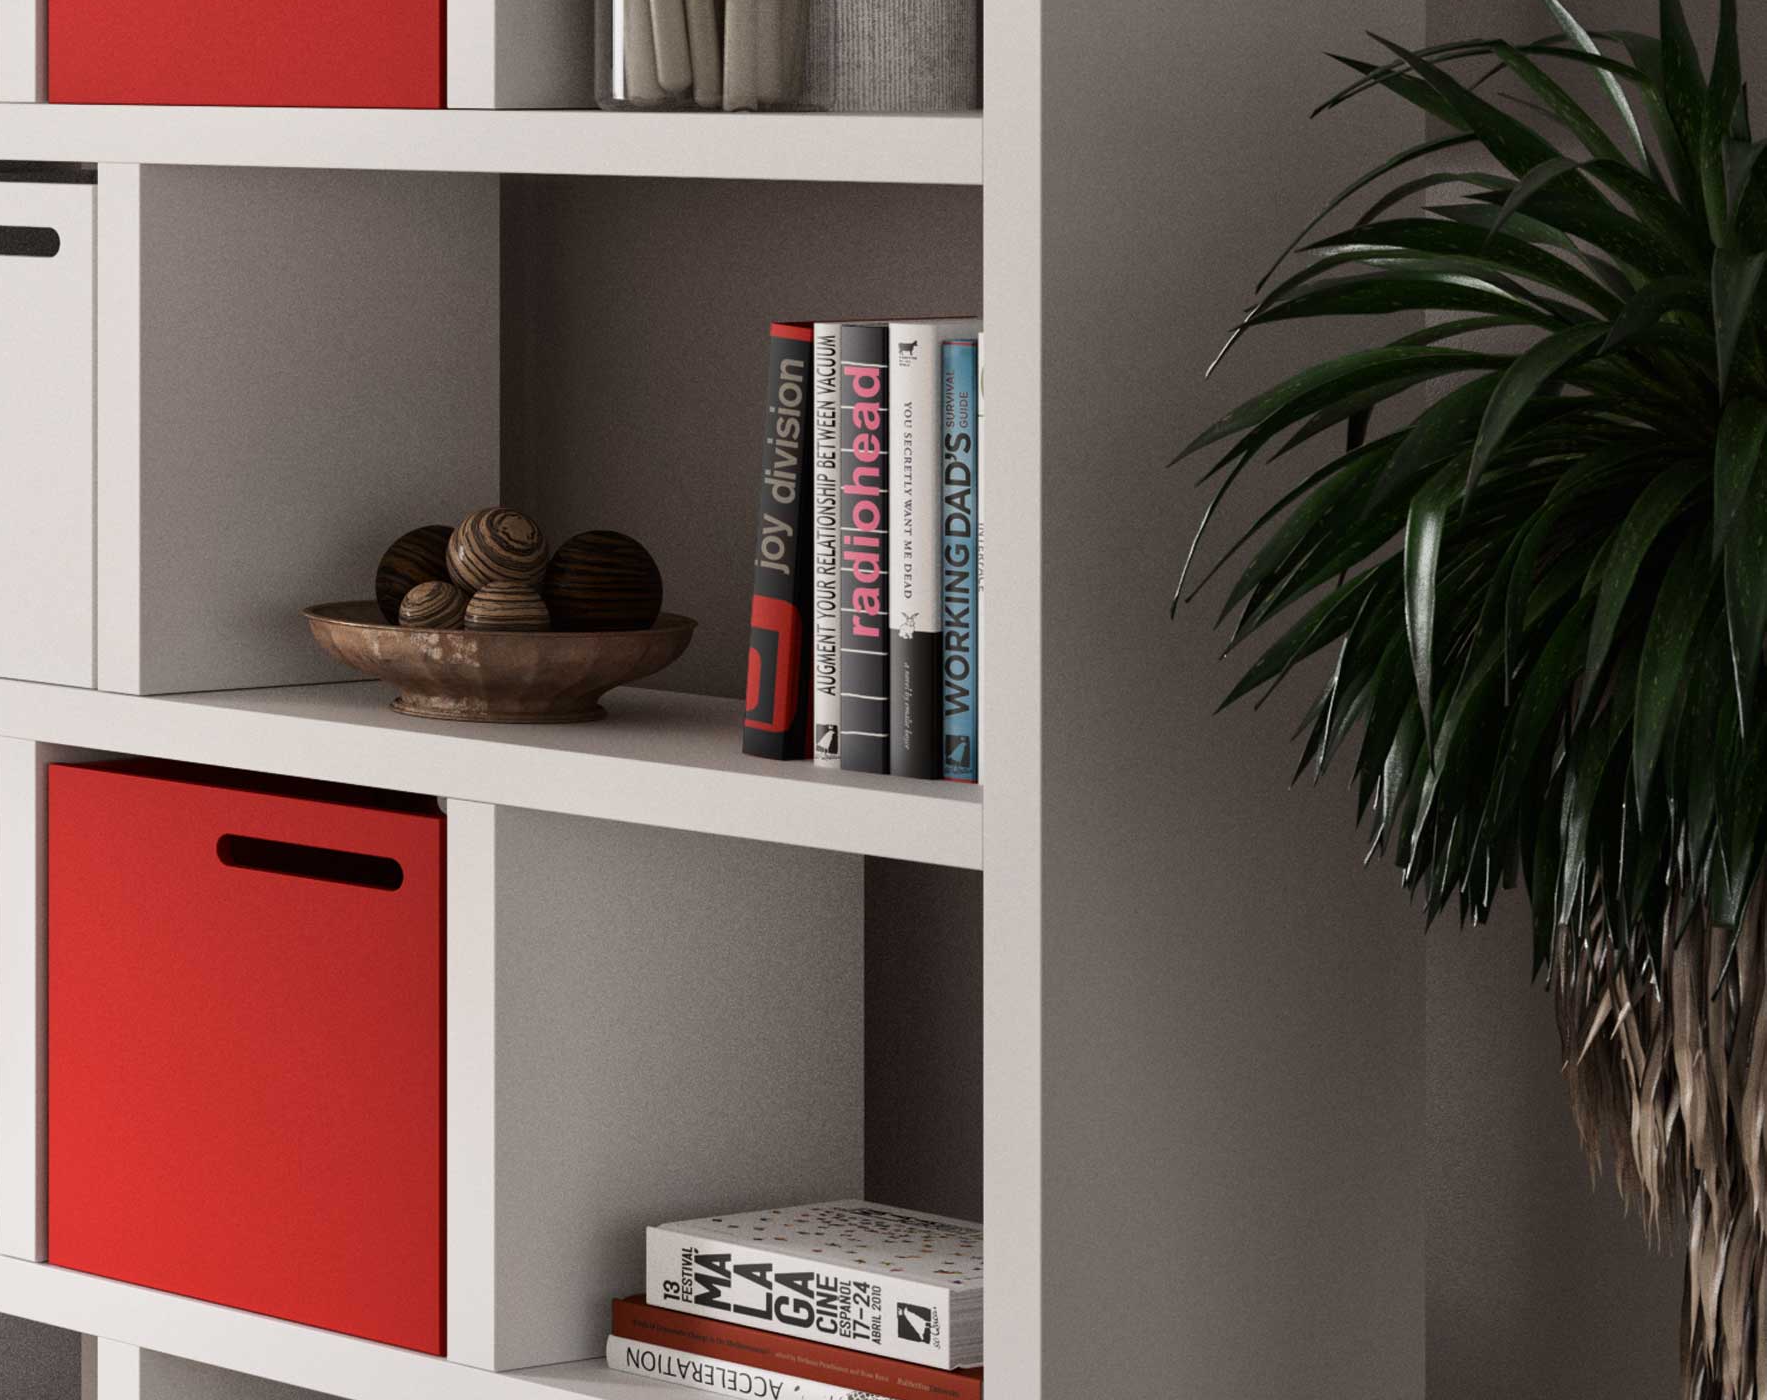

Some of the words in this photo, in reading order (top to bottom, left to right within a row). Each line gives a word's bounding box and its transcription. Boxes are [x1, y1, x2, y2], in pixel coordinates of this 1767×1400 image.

[817, 335, 836, 398] VACUUM
[903, 402, 912, 428] YOU
[945, 371, 955, 428] SURVIVAL
[959, 391, 968, 428] GUIDE
[766, 358, 804, 500] division
[817, 399, 836, 471] BETWEEN
[903, 432, 912, 496] SECRETLY
[943, 431, 971, 538] DAD'S
[817, 474, 836, 578] RELATIONSHIP
[842, 366, 882, 640] radiohead
[903, 499, 912, 536] WANT
[755, 513, 793, 575] joy
[903, 540, 912, 560] ME
[817, 580, 836, 622] YOUR
[903, 563, 912, 599] DEAD
[943, 543, 970, 717] WORKING
[817, 624, 836, 696] AUGMENT
[663, 1280, 680, 1302] 13
[682, 1247, 693, 1303] FESTIVAL
[694, 1247, 732, 1310] MÁ
[733, 1263, 773, 1321] LA
[775, 1271, 815, 1329] GA
[871, 1285, 881, 1316] 2010
[816, 1274, 838, 1335] CINE
[838, 1279, 851, 1339] ESPAÑOL
[872, 1318, 881, 1344] ABRIL
[626, 1346, 783, 1400] ACCELERATION
